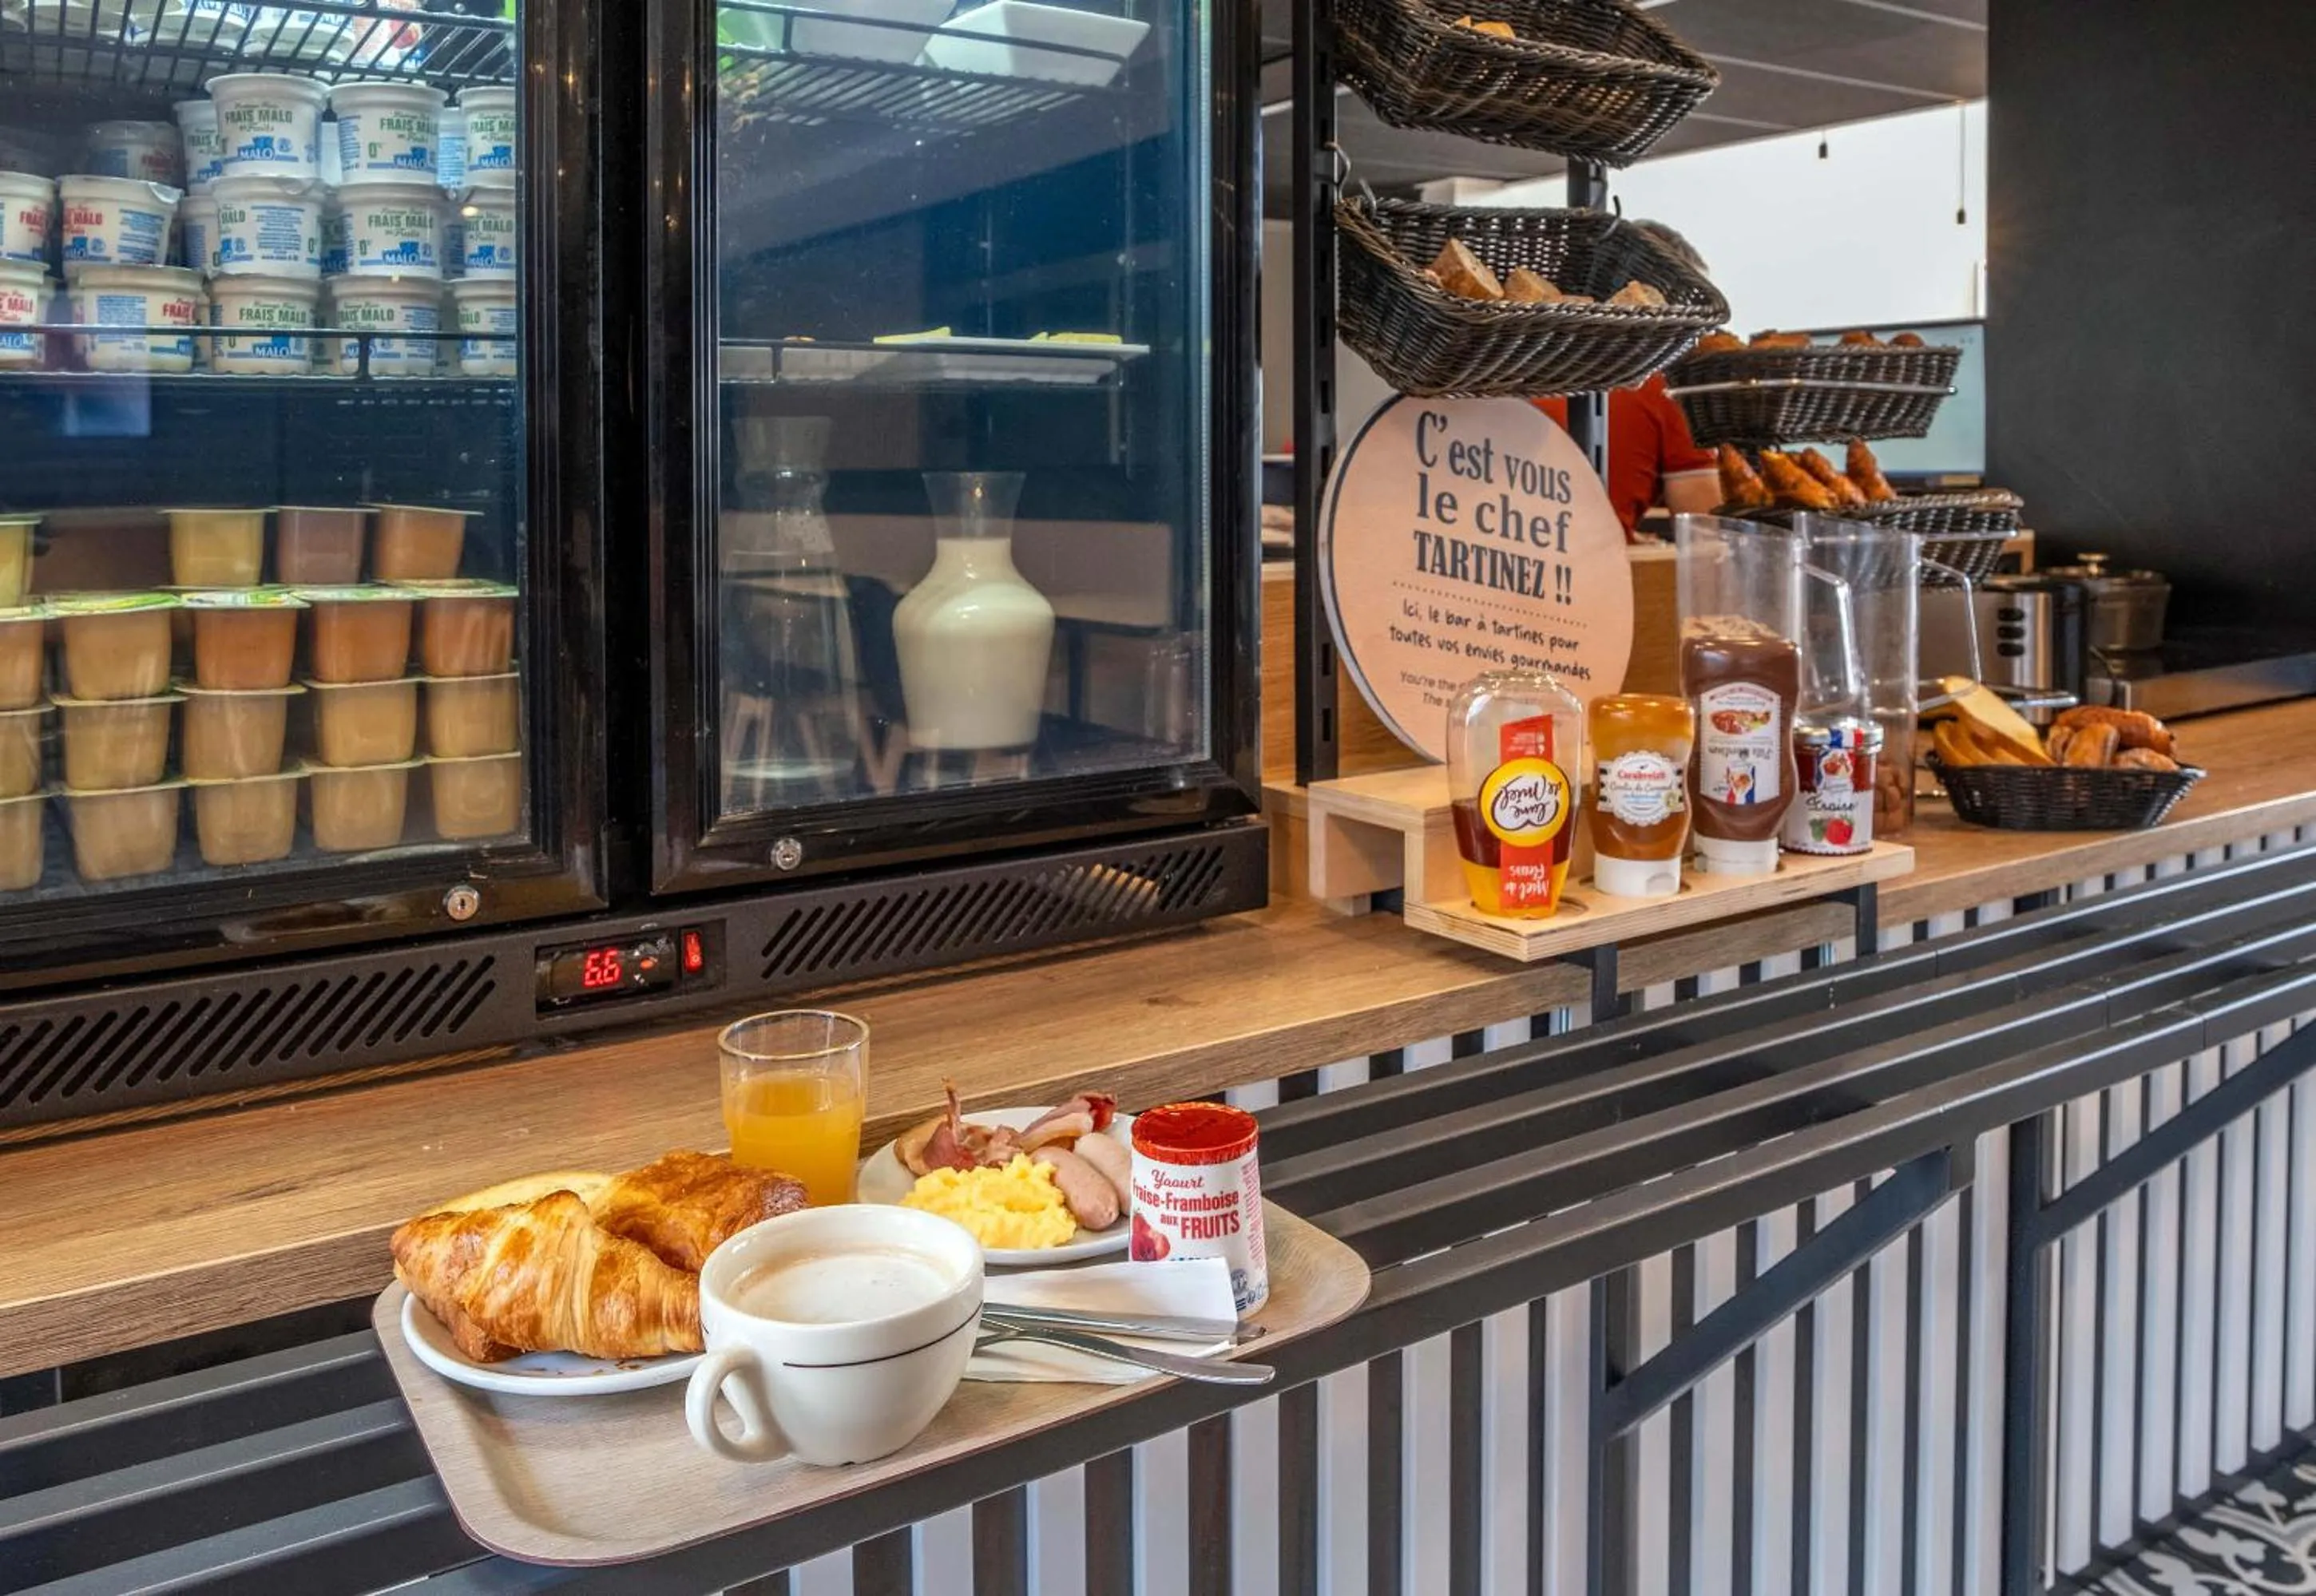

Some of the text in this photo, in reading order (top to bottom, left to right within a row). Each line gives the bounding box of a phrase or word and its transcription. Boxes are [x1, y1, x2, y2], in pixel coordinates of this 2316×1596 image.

[258, 109, 293, 124] MALO
[380, 117, 414, 131] FRAIS
[240, 148, 273, 160] MALO
[395, 156, 426, 168] MALO
[480, 156, 510, 167] MALO
[367, 214, 402, 228] FRAIS
[482, 219, 514, 233] MALO
[385, 252, 419, 264] MALO
[239, 307, 275, 321] FRAIS
[362, 308, 395, 322] MALO
[0, 335, 22, 348] ALO
[256, 345, 290, 358] MALO
[1504, 453, 1572, 505] vous
[1417, 472, 1572, 554] le chef
[1414, 529, 1572, 605] TARTINEZ !!
[1403, 598, 1579, 654] Ici, le bar à tartines pour
[1389, 624, 1592, 680] toutes vos envies gourmandes
[1438, 679, 1457, 691] the
[1422, 692, 1443, 707] The
[1547, 781, 1562, 797] de
[1508, 862, 1545, 878] Fleurs
[1504, 879, 1550, 900] Miel de
[1151, 1169, 1206, 1190] Yaourt
[1160, 1210, 1241, 1240] aux FRUITS
